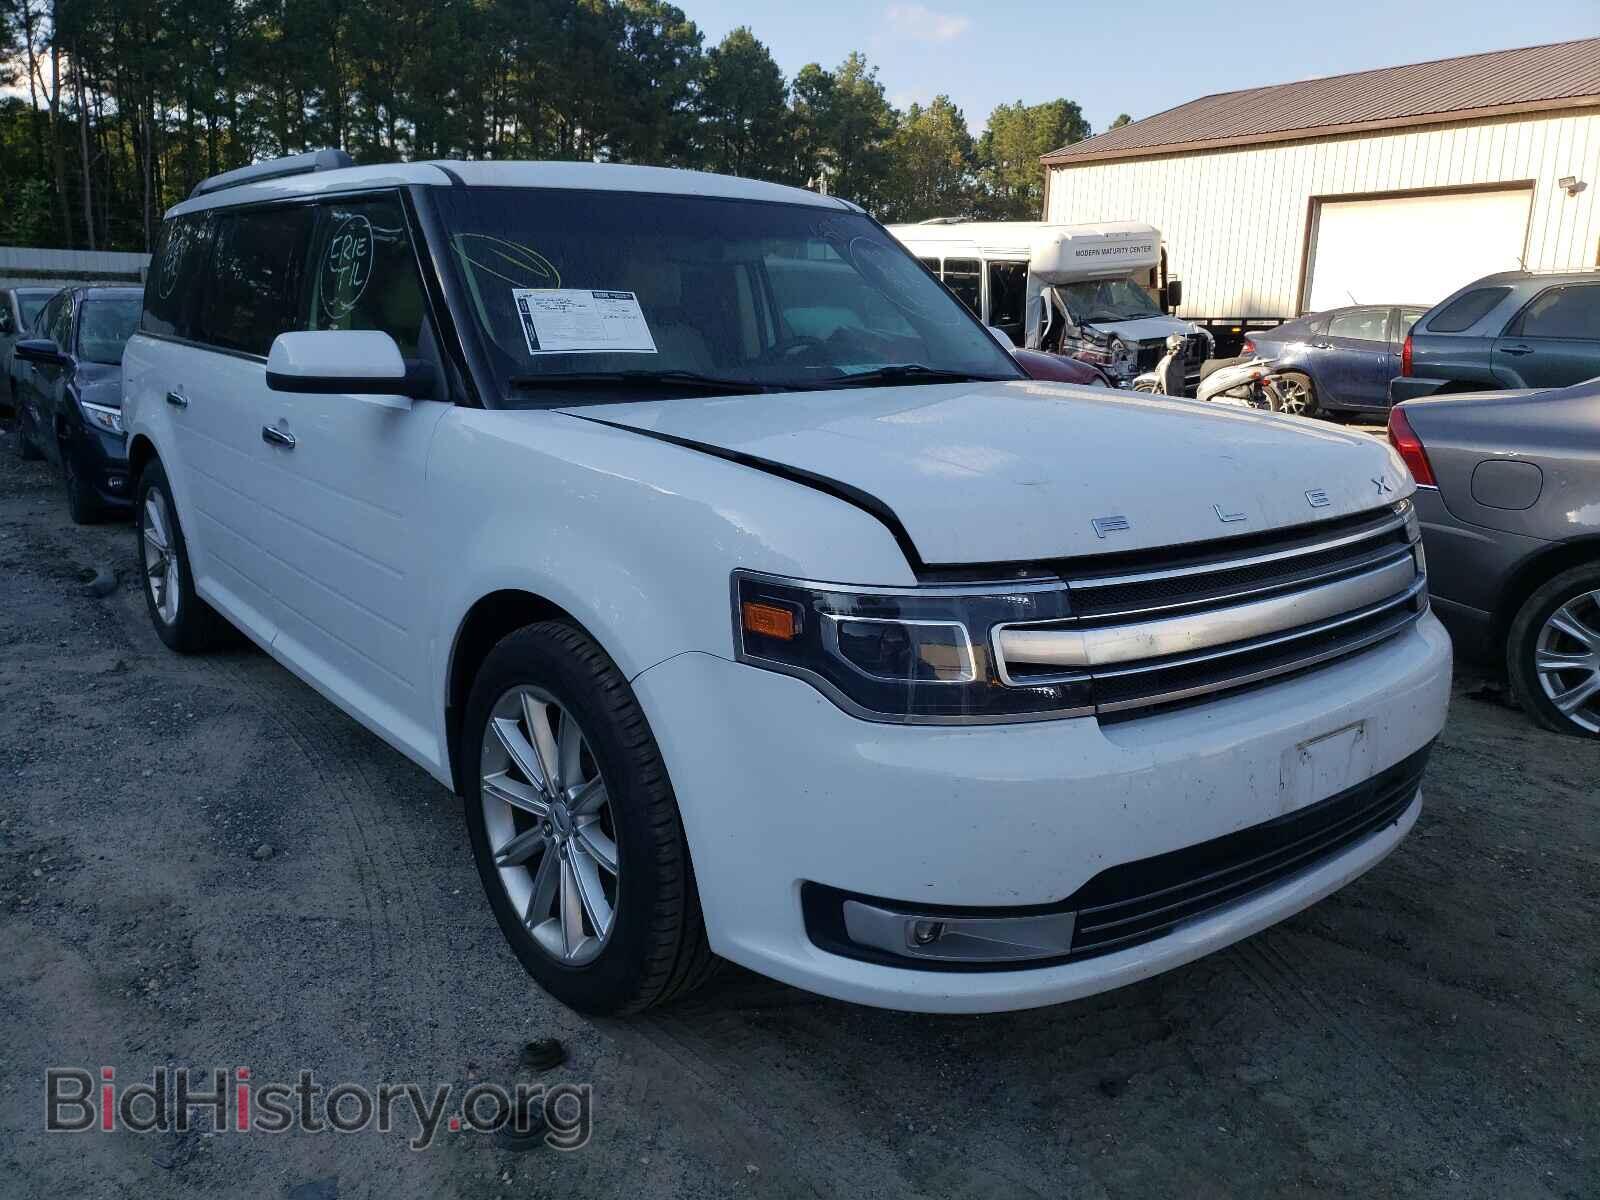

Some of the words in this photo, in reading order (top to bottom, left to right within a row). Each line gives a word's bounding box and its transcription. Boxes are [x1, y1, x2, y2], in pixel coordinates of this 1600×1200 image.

[1075, 248, 1100, 256] MODERN
[1101, 247, 1129, 255] MATURITY
[1130, 245, 1152, 254] CENTER
